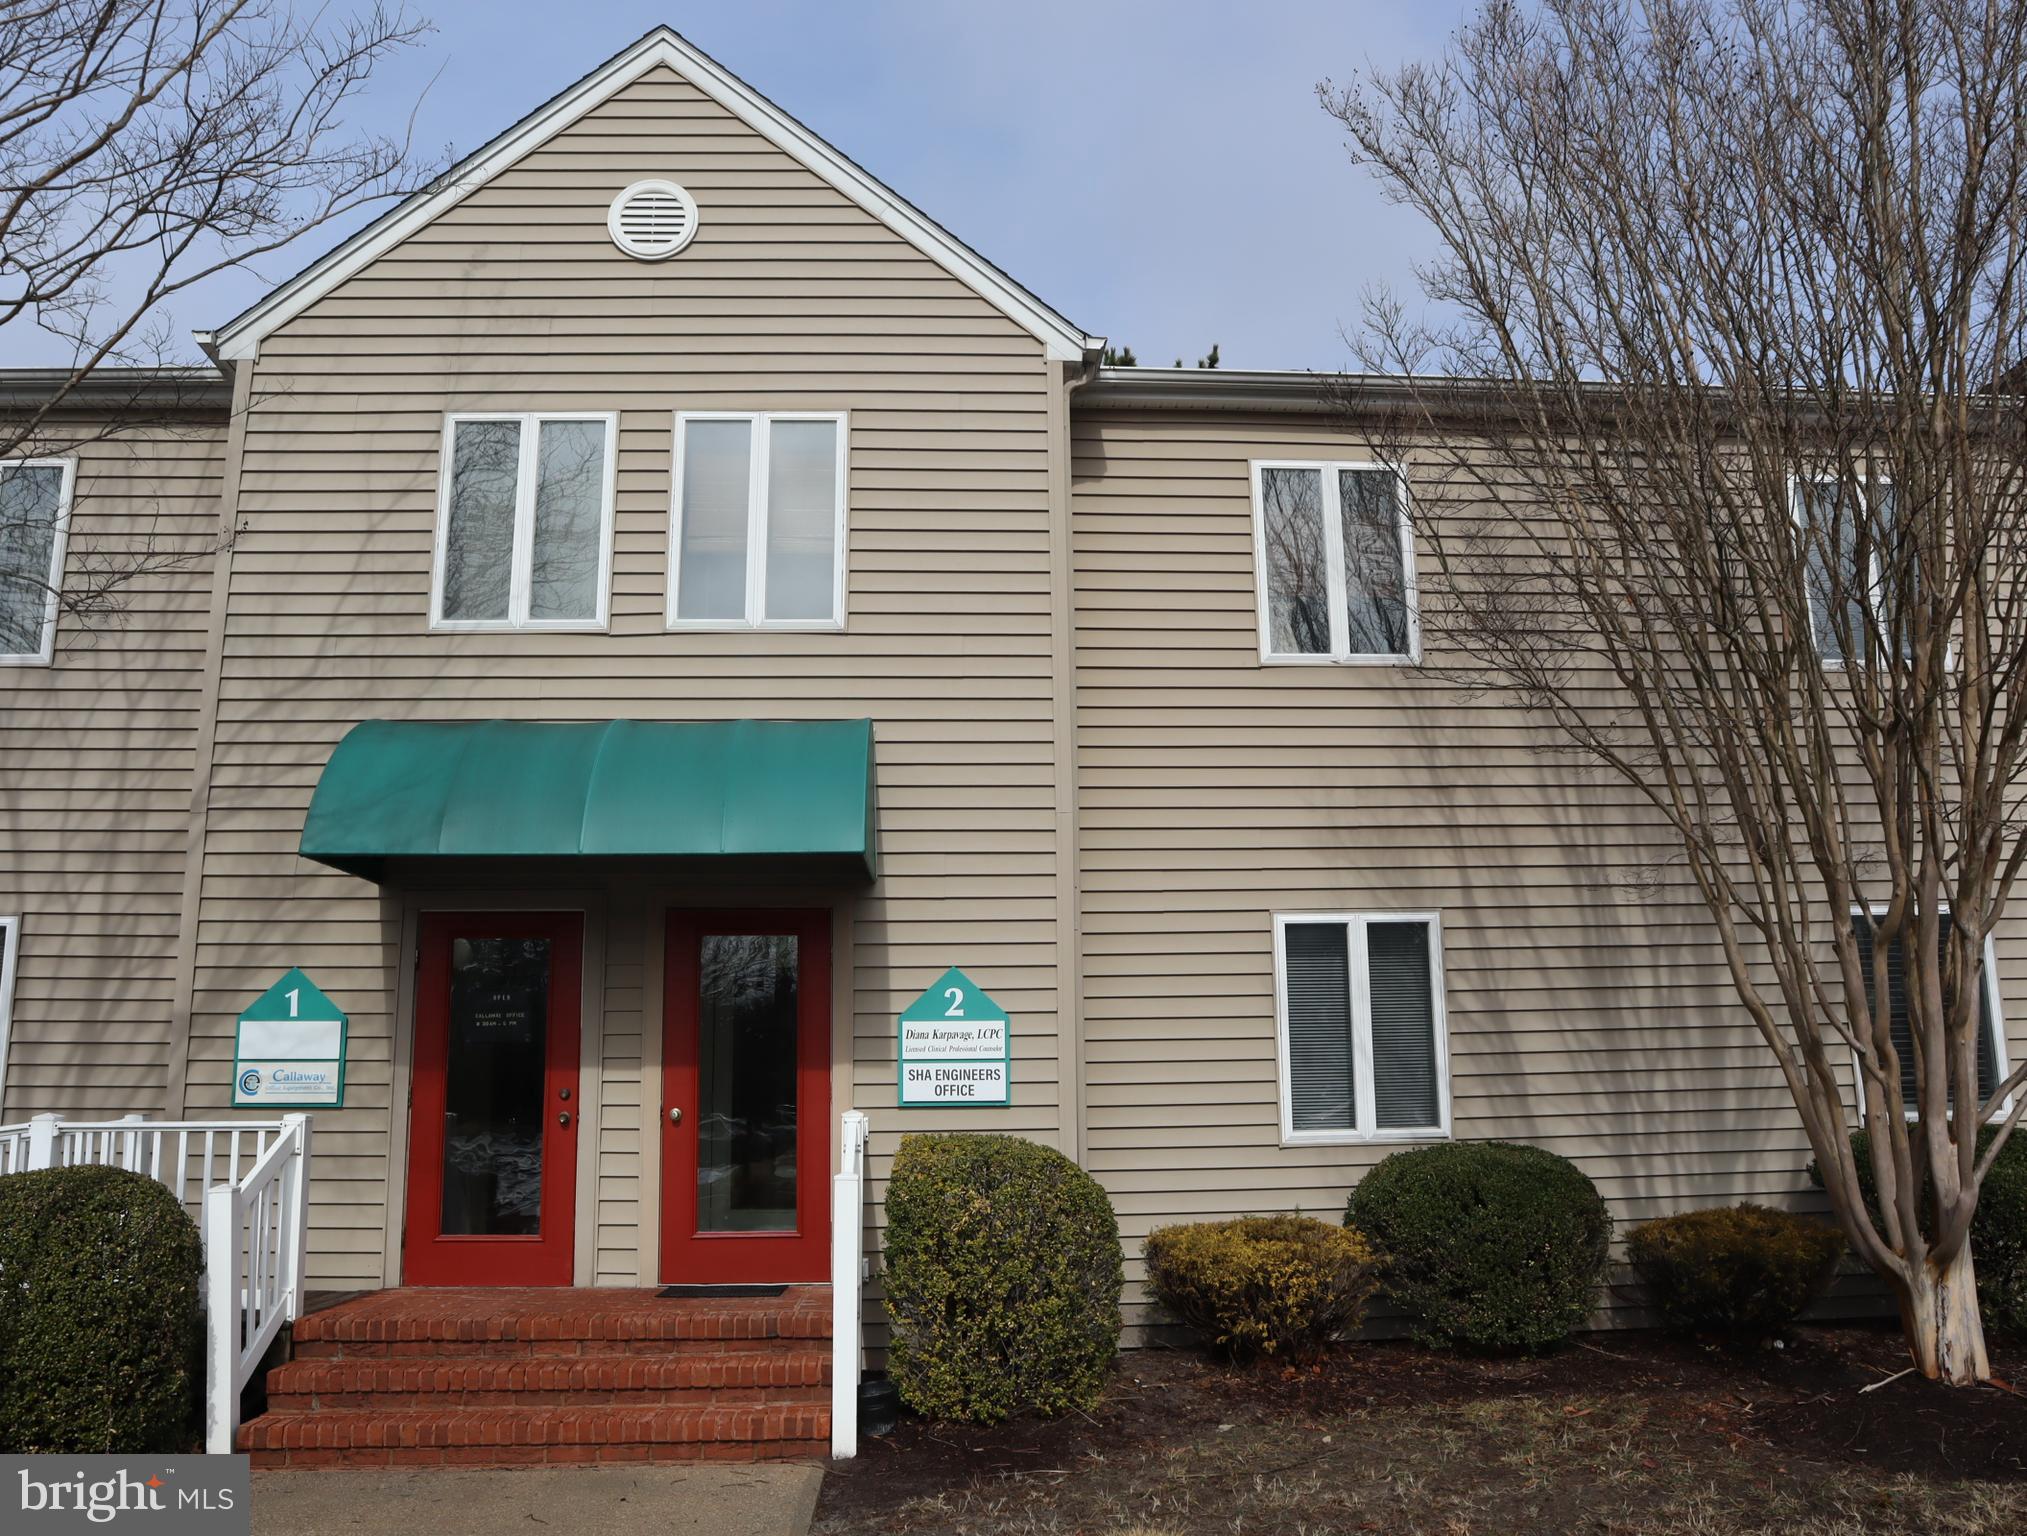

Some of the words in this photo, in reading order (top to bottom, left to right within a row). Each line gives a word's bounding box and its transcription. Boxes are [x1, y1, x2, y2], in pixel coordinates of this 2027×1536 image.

[284, 988, 299, 1017] 1
[944, 987, 965, 1017] 2
[905, 1029, 929, 1040] Diana
[932, 1029, 975, 1042] Karpavage,
[977, 1028, 1003, 1040] LCPC
[905, 1045, 926, 1053] Licensed
[928, 1045, 947, 1053] Clinical
[949, 1045, 978, 1053] Professional
[979, 1044, 1003, 1053] Counselor
[272, 1069, 326, 1083] Callaway
[908, 1069, 932, 1081] SHA
[935, 1068, 1001, 1081] ENGINEERS
[934, 1084, 975, 1097] OFFICE
